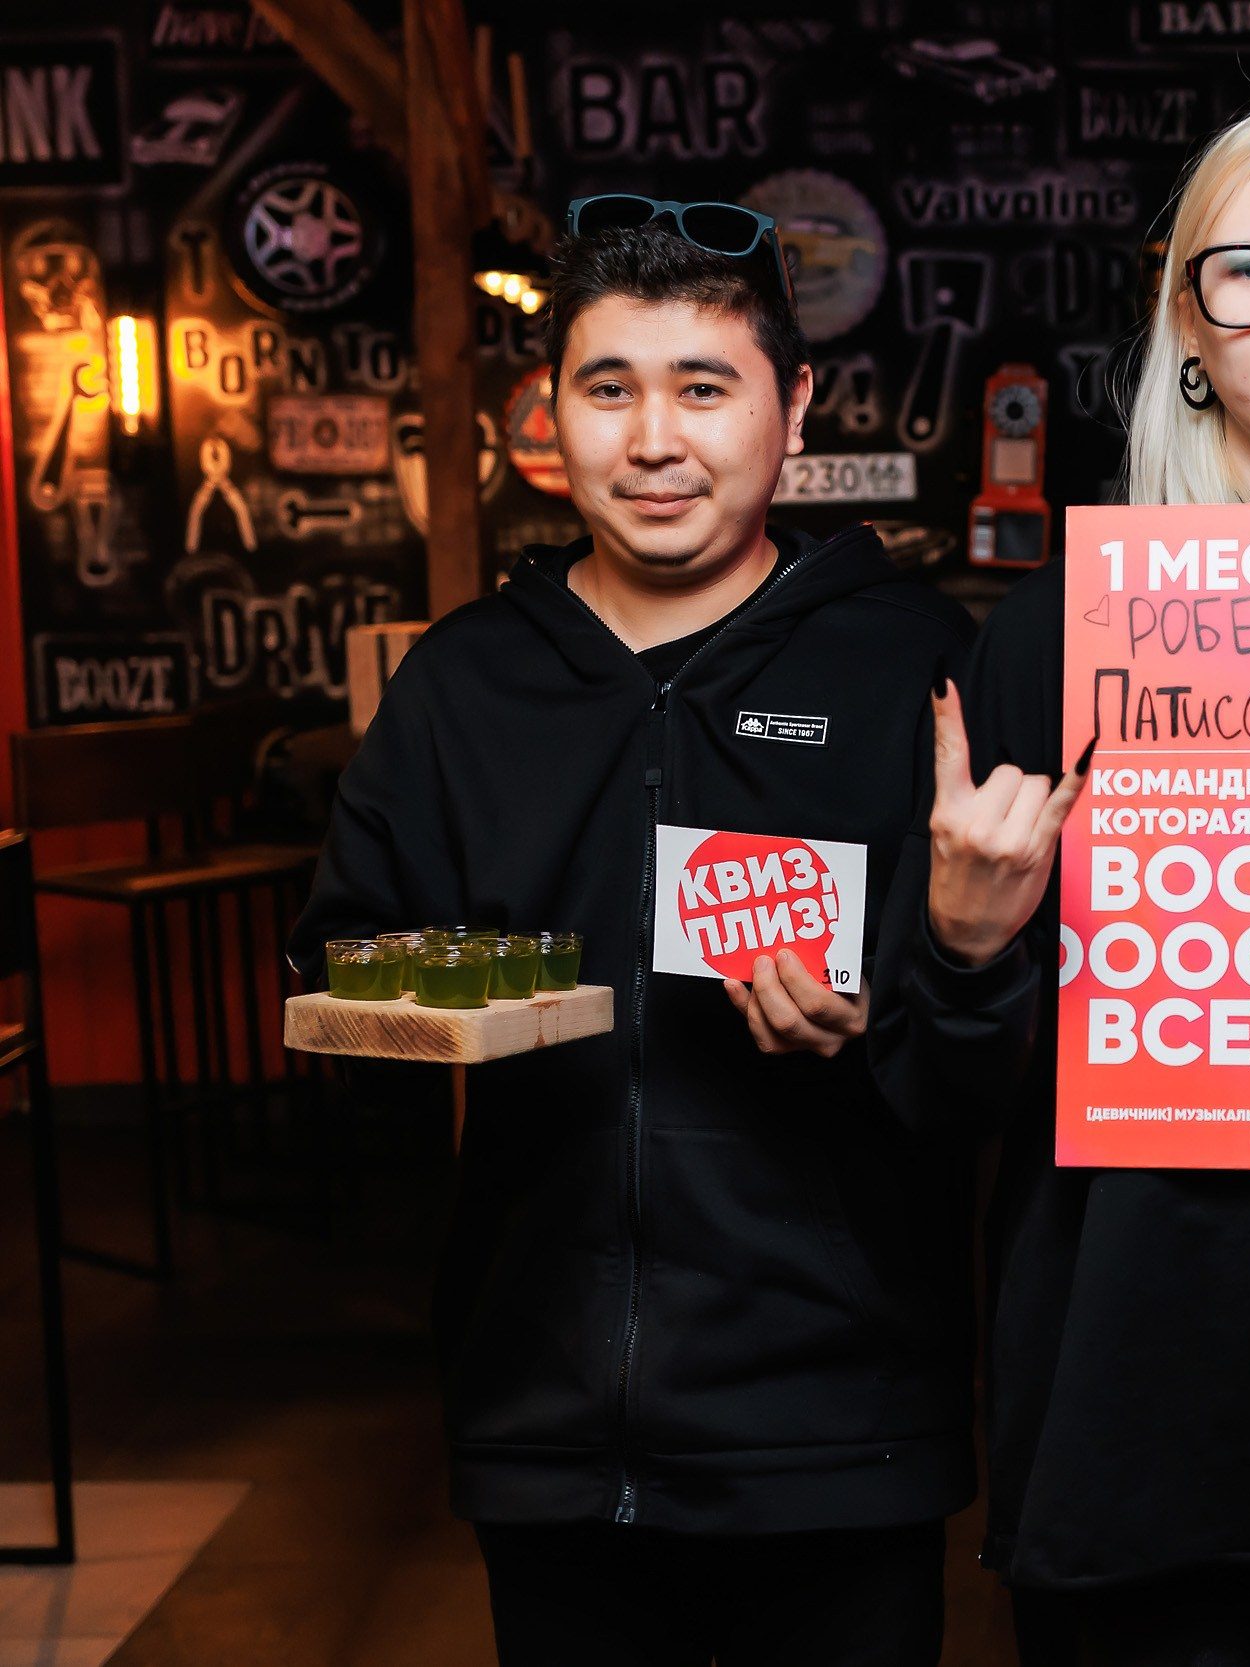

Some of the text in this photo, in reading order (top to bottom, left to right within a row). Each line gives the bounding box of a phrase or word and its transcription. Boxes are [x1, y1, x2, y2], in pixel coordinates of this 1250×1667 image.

[0, 64, 102, 163] NK
[572, 62, 759, 153] BAR
[902, 180, 1136, 222] Valvoline
[184, 328, 319, 395] BORN
[342, 328, 399, 381] TO
[1100, 540, 1125, 592] 1
[56, 657, 177, 713] BOOZE
[777, 727, 797, 736] SINCE
[683, 847, 834, 911] КВИЗ,
[684, 893, 838, 959] ПЛИЗ!
[1086, 1106, 1172, 1122] [ДЕВИЧНИК]
